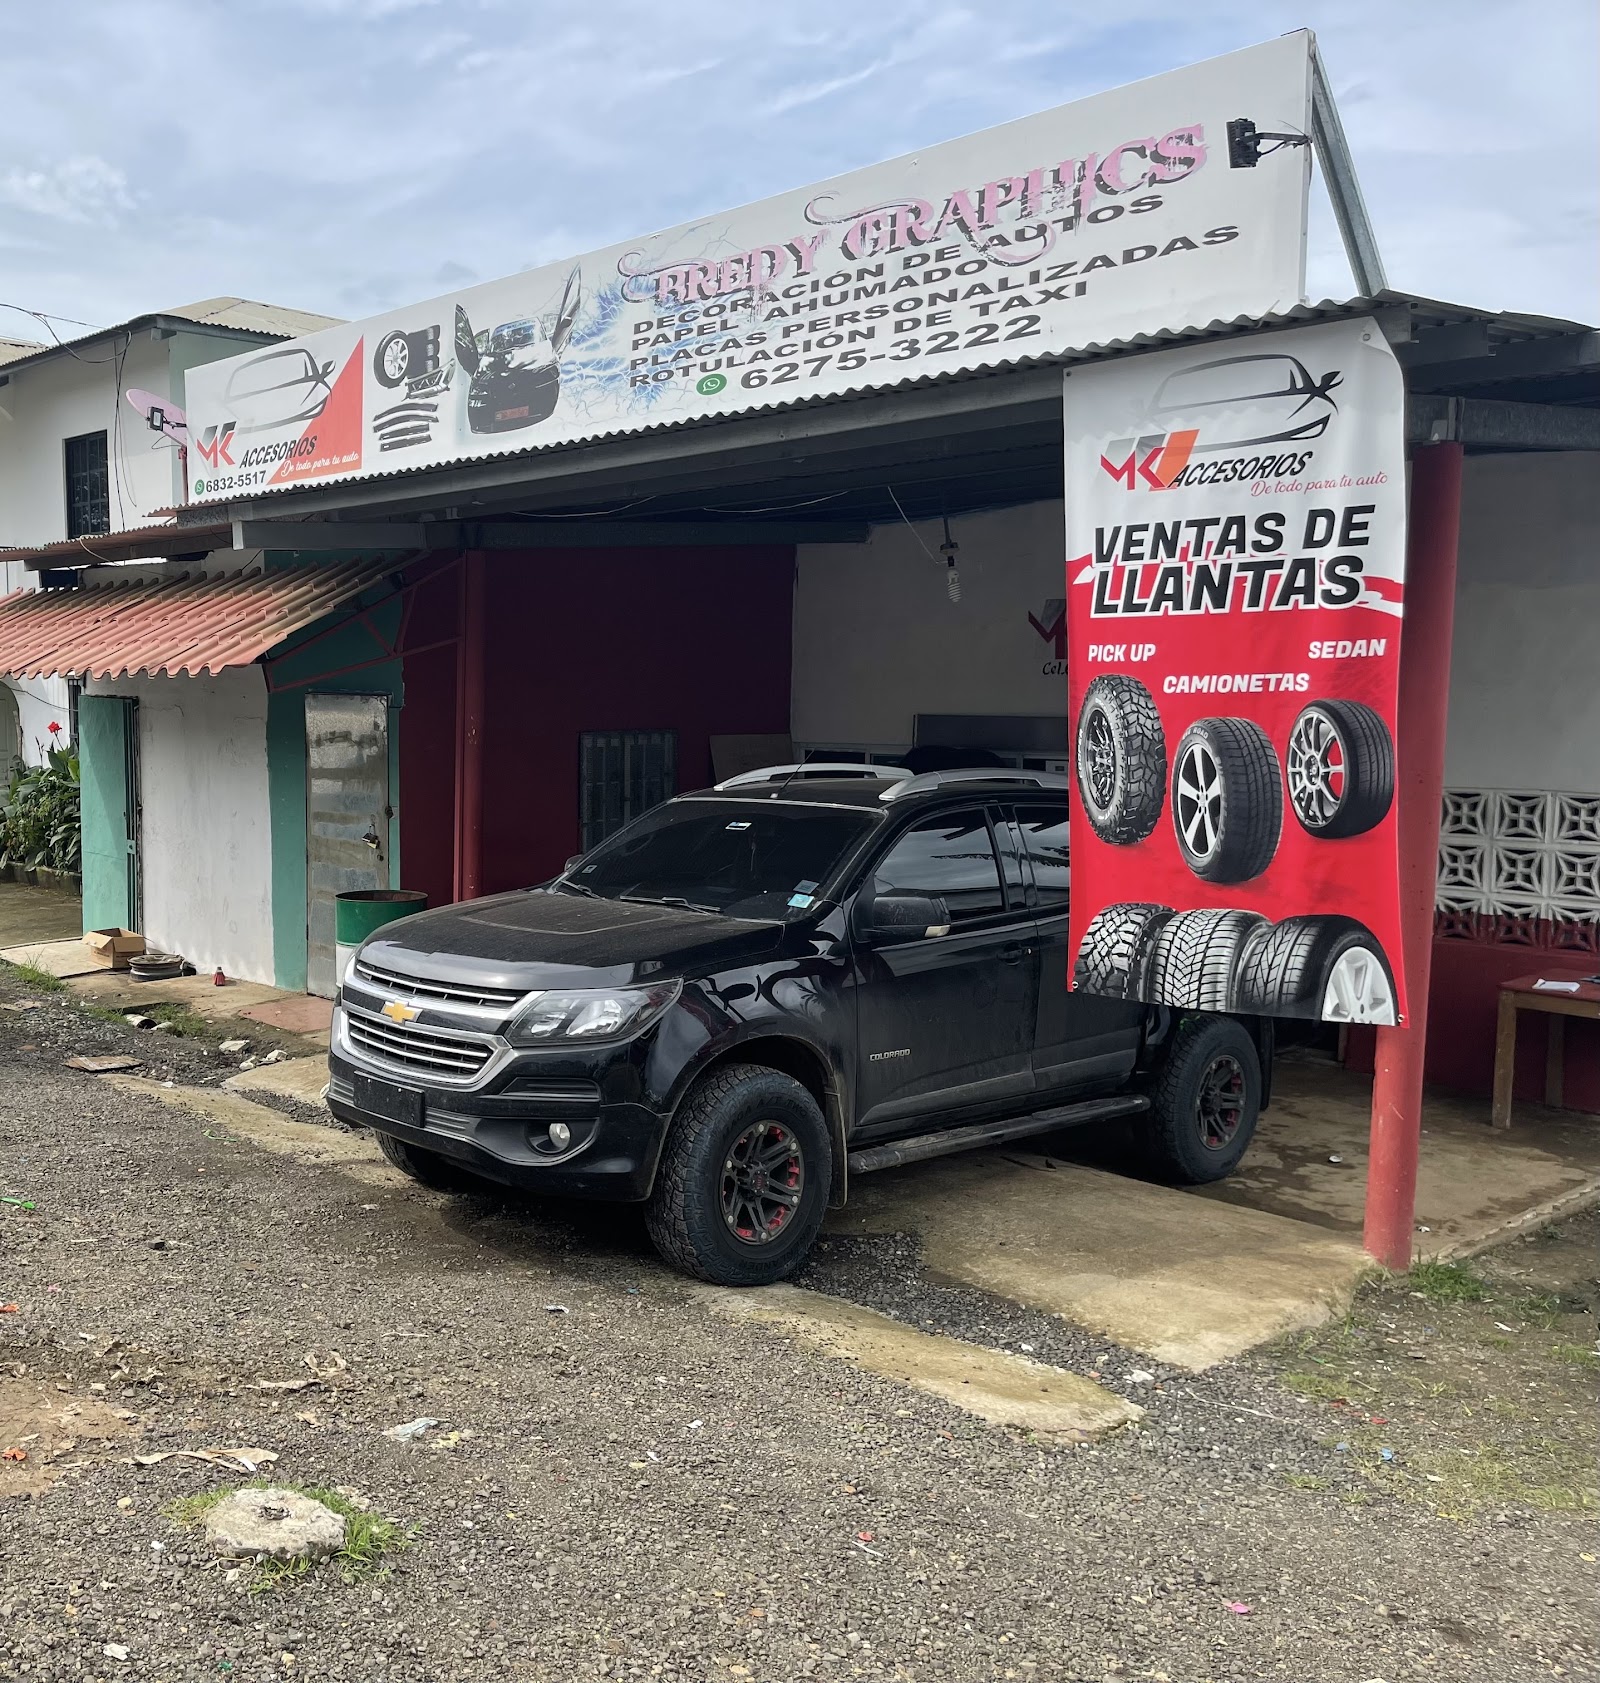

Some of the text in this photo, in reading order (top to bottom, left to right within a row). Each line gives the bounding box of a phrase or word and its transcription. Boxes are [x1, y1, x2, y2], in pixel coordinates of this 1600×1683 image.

[804, 123, 1208, 267] GRAPHICS
[633, 195, 1164, 335] DECORACIÓN DE AUTOS
[630, 226, 1240, 370] PLACAS PERSONALIZADAS
[632, 259, 988, 351] PAPEL AHUMADO
[630, 281, 1087, 387] ROTULACIÓN DE TAXI
[740, 314, 1041, 389] 6275-3222
[240, 435, 317, 469] ACCESORIOS
[280, 451, 359, 477] De todo para tu auto
[1168, 451, 1313, 488] ACCESORIOS
[206, 470, 267, 493] 6832-5517
[1251, 472, 1388, 497] De todo para tu auto
[1094, 504, 1376, 564] VENTAS DE
[1092, 555, 1364, 615] LLANTAS
[1028, 599, 1067, 660] M
[1088, 643, 1156, 662] PICK UP
[1308, 638, 1386, 660] SEDAN
[1162, 673, 1310, 694] CAMIONETAS
[869, 1048, 911, 1061] COLORADO
